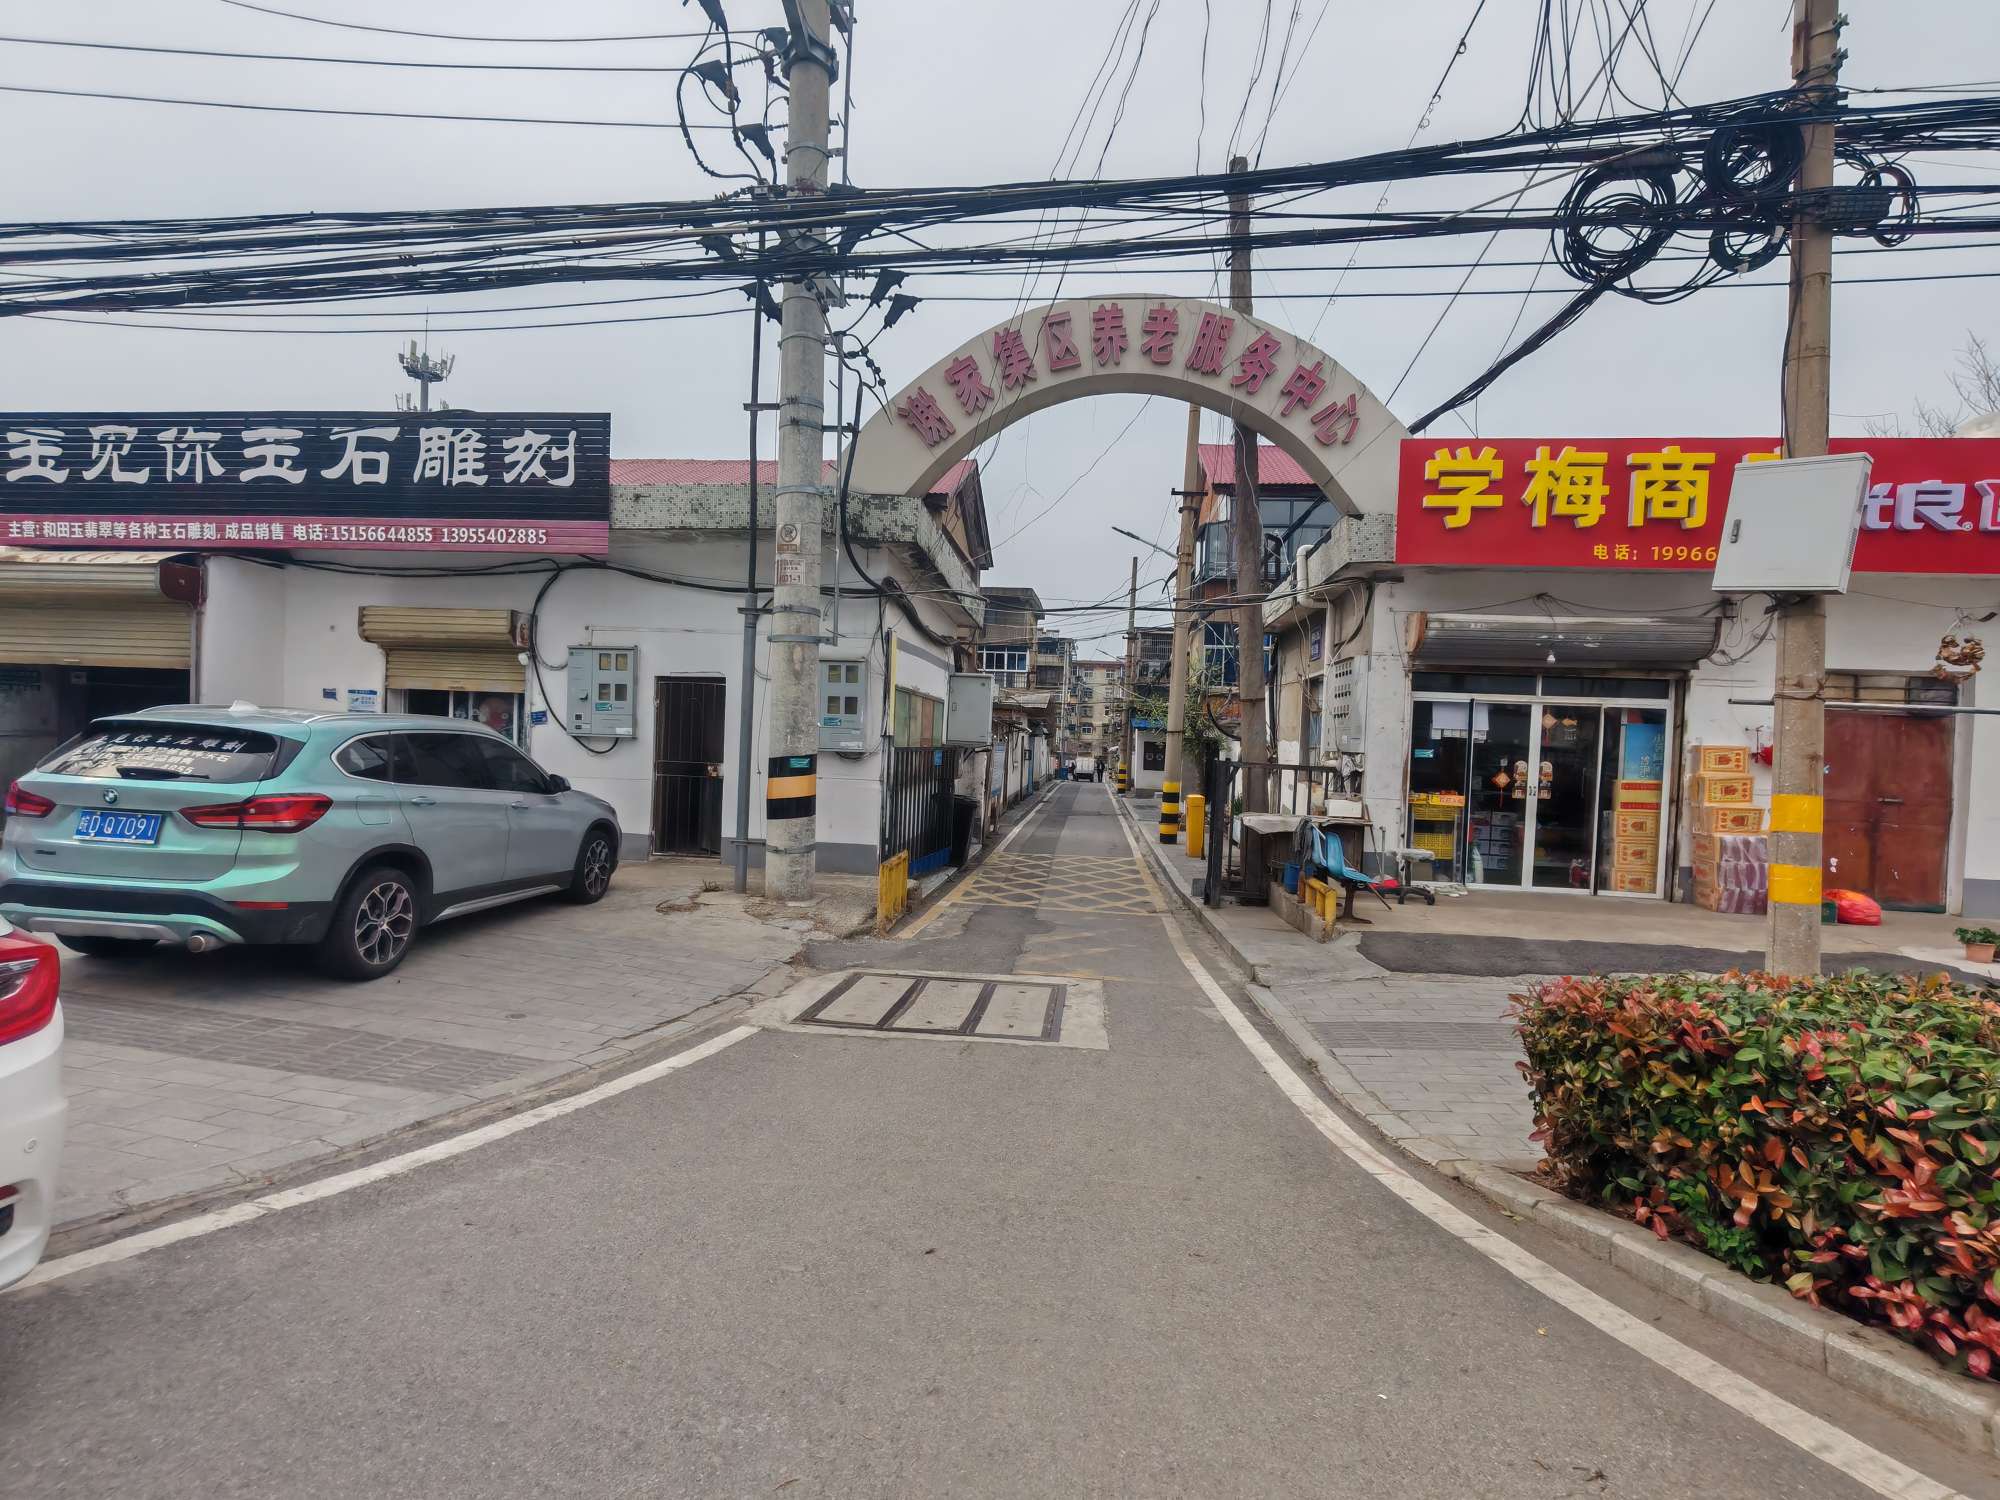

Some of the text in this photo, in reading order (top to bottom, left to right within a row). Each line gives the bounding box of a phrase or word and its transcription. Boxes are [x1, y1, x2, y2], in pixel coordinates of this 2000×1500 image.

[897, 302, 1361, 447] 谢家集区养老服务中心
[5, 424, 577, 487] 玉见你玉石雕刻
[1422, 445, 1784, 530] 学梅商
[441, 526, 547, 545] 13955402885
